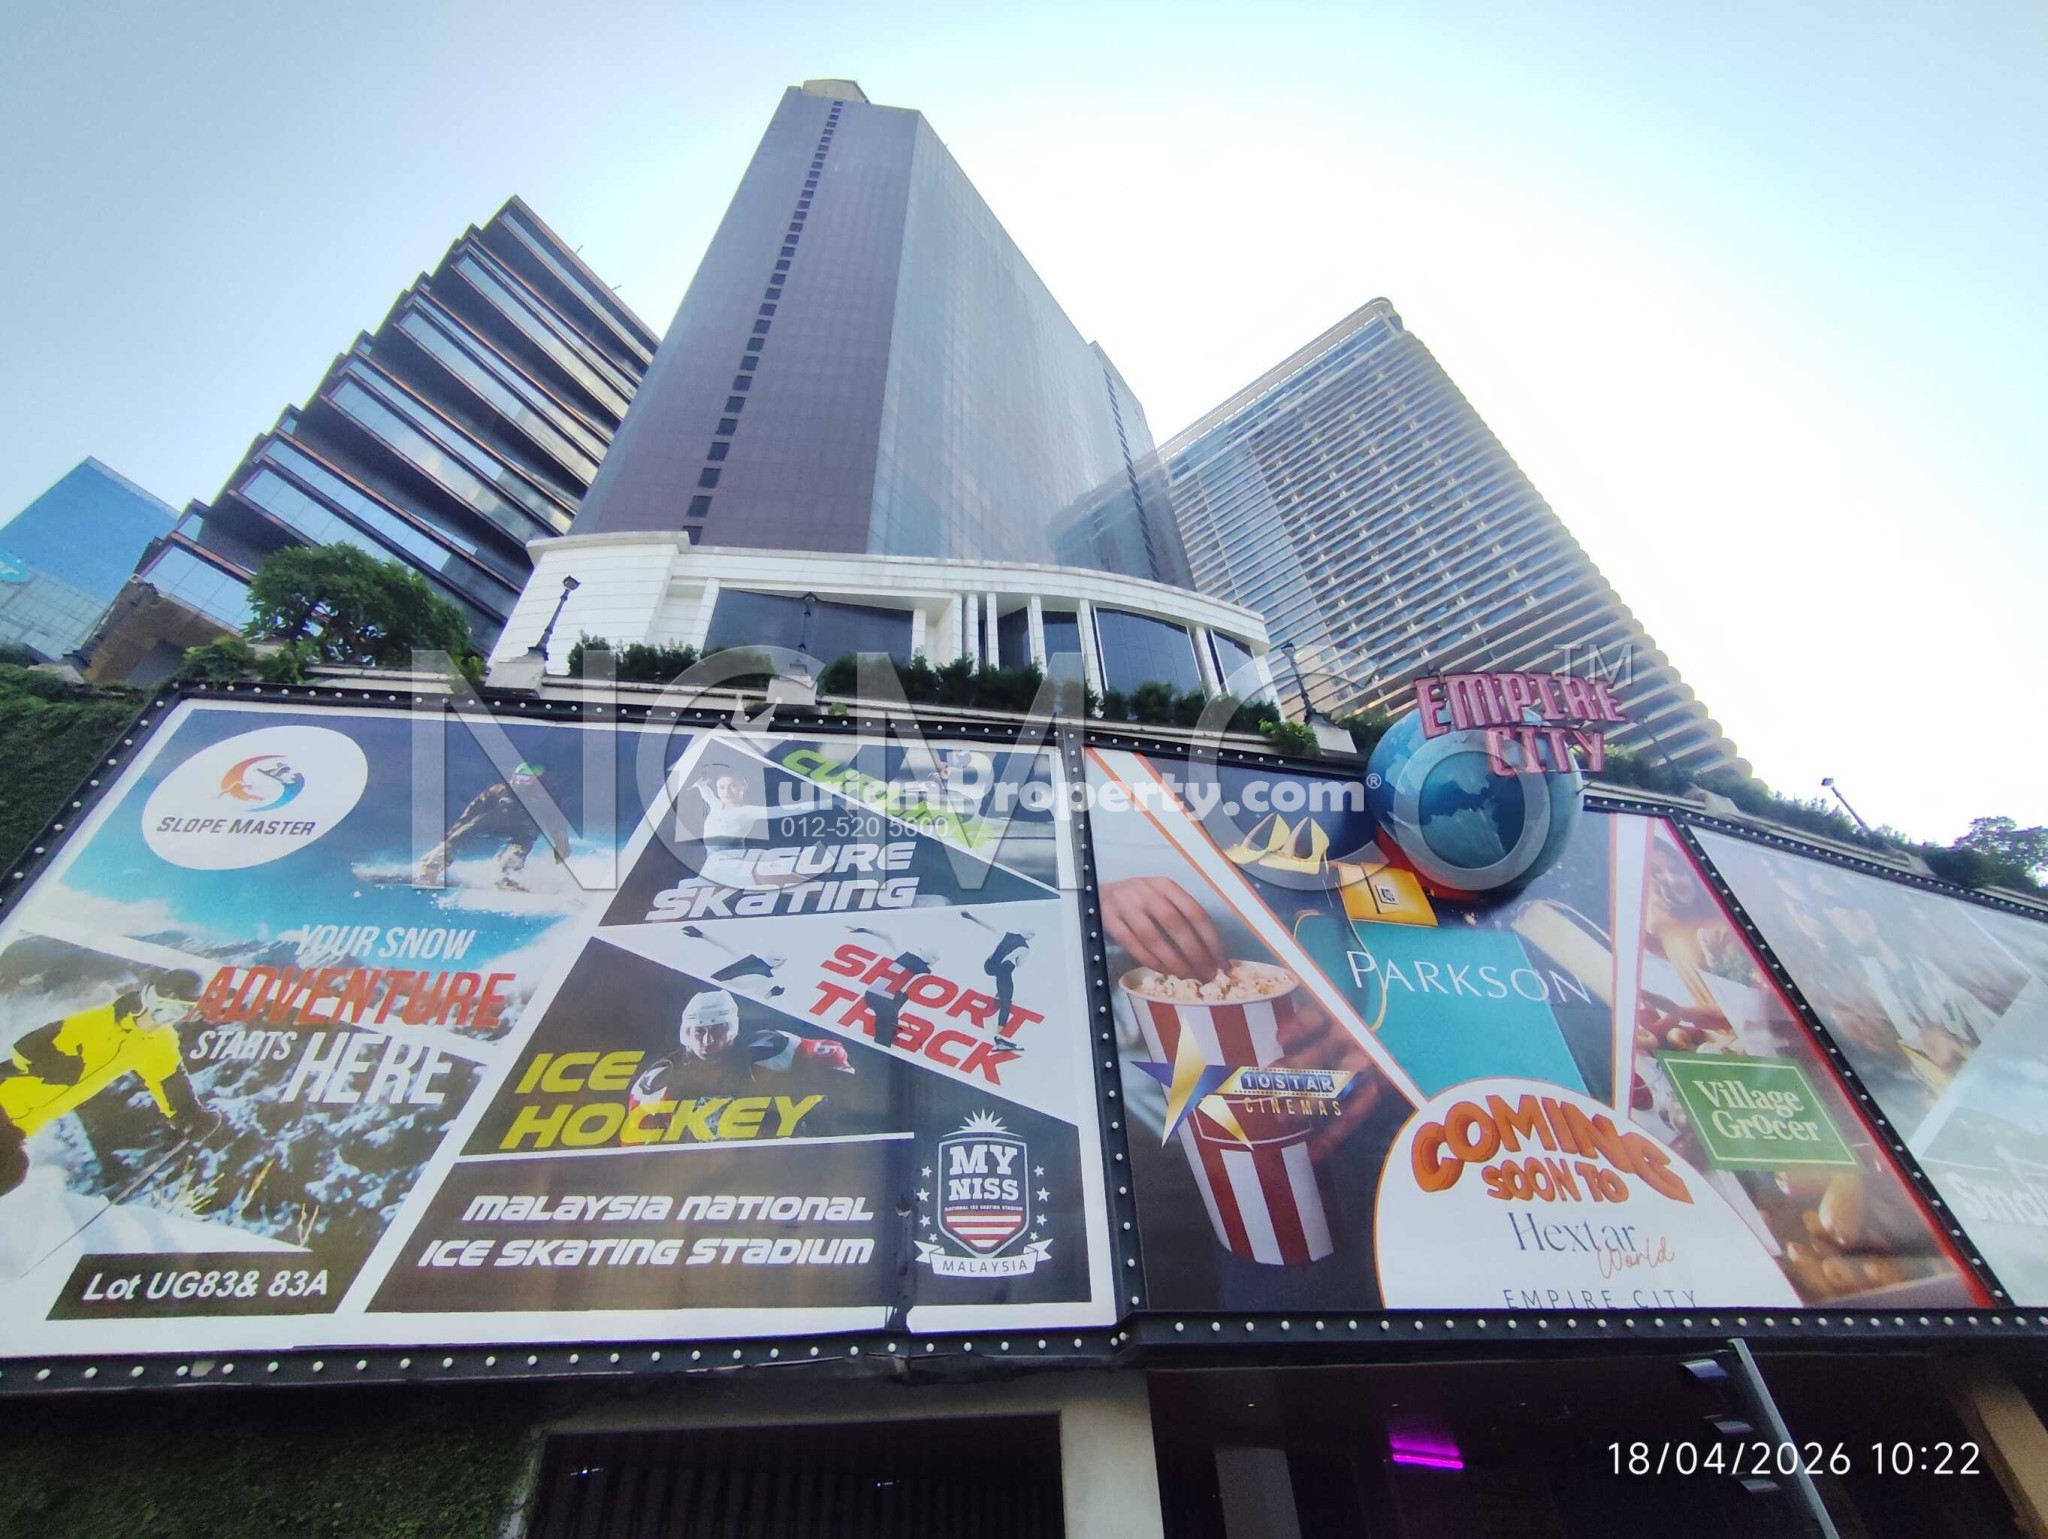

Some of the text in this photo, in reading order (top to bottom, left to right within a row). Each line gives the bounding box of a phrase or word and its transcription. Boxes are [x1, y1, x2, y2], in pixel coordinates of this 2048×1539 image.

[1414, 671, 1627, 740] EMPIRE
[1487, 725, 1605, 777] CITY
[157, 817, 316, 835] SLOPE MASTER
[700, 842, 917, 877] FIGURE
[296, 924, 477, 960] YOUR SNOW
[187, 964, 516, 1028] ADVENTURE
[820, 943, 1045, 1039] SHORT
[1346, 951, 1592, 1005] PARKSON
[190, 1031, 454, 1104] STARTS HERE
[514, 1050, 645, 1094] ICE
[1244, 1097, 1342, 1116] CINEMAS
[1692, 1080, 1804, 1118] Village
[499, 1094, 828, 1149] HOCKEY
[1711, 1110, 1821, 1141] Grocer
[949, 1144, 1018, 1175] MY
[1411, 1094, 1695, 1205] COMING
[948, 1178, 1019, 1200] NISS
[1481, 1157, 1629, 1203] SOON TO
[1507, 1212, 1637, 1252] Hextar
[417, 1239, 496, 1266] ICE
[942, 1259, 1028, 1273] MALAYSIA
[1597, 1236, 1675, 1279] World
[83, 1270, 328, 1300] Lot UG83& 83A
[1503, 1289, 1697, 1309] EMPIRE CITY
